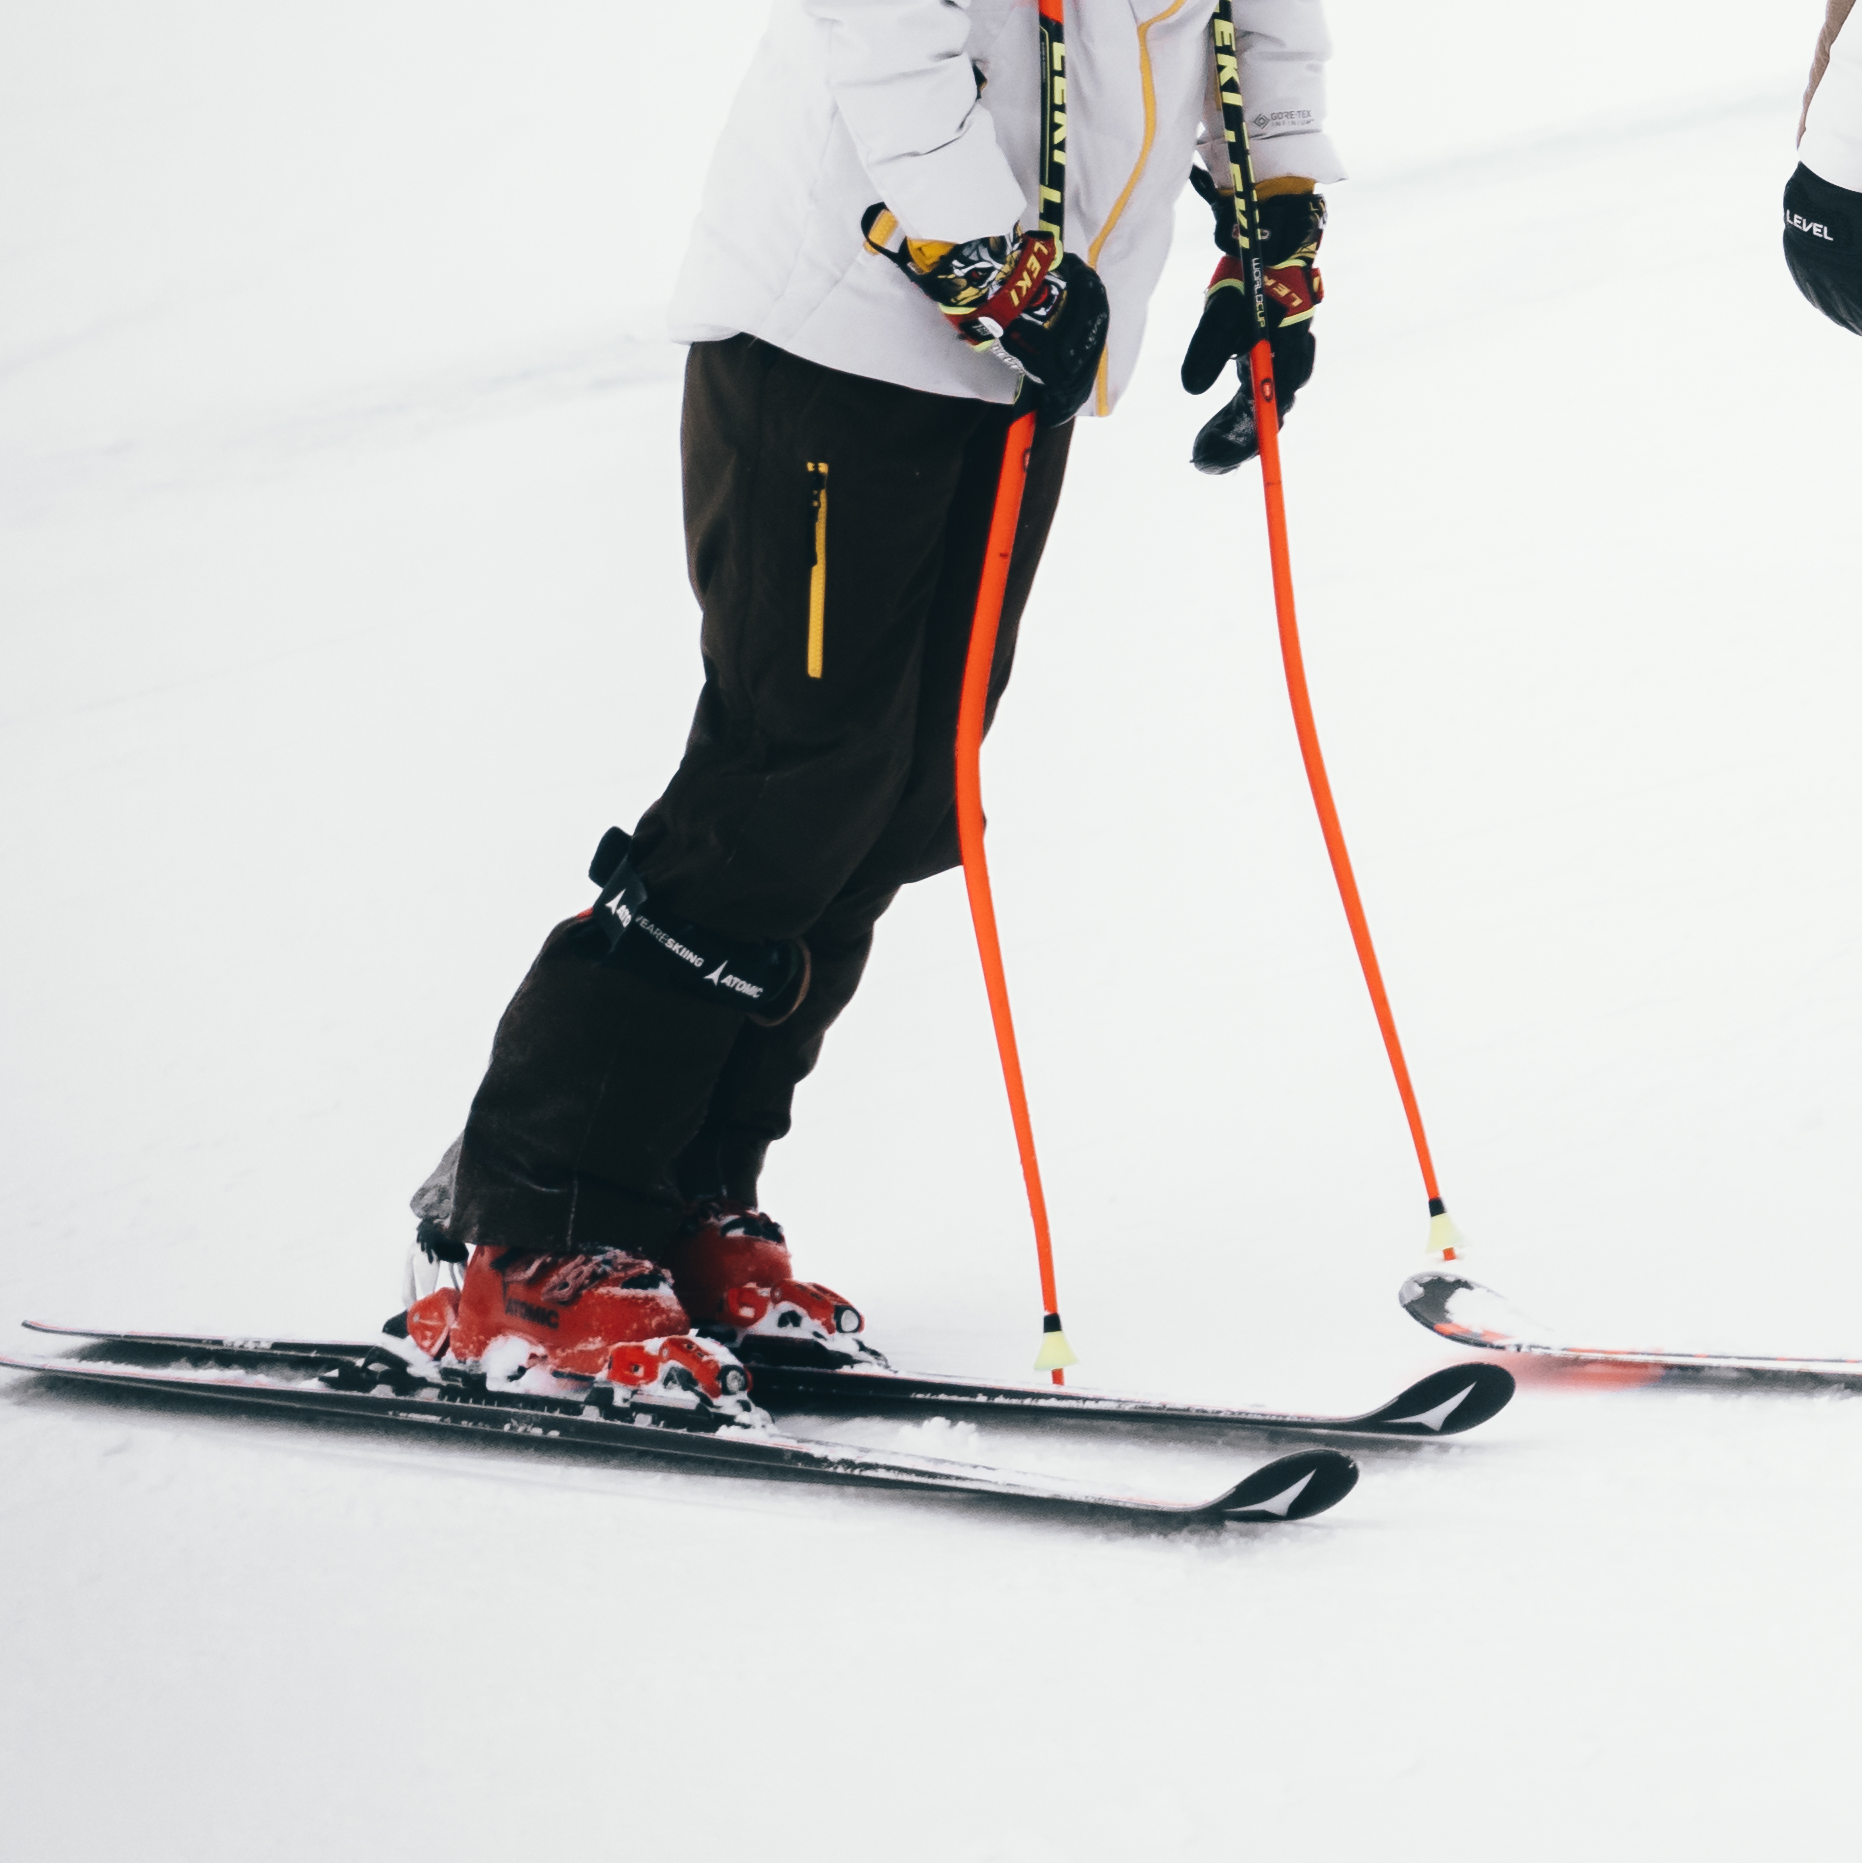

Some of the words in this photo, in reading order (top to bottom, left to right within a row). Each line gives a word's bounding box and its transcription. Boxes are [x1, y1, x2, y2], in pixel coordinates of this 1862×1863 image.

[1786, 209, 1833, 241] LEVEL
[1009, 241, 1049, 307] LEKI
[720, 974, 764, 998] ATOMIC
